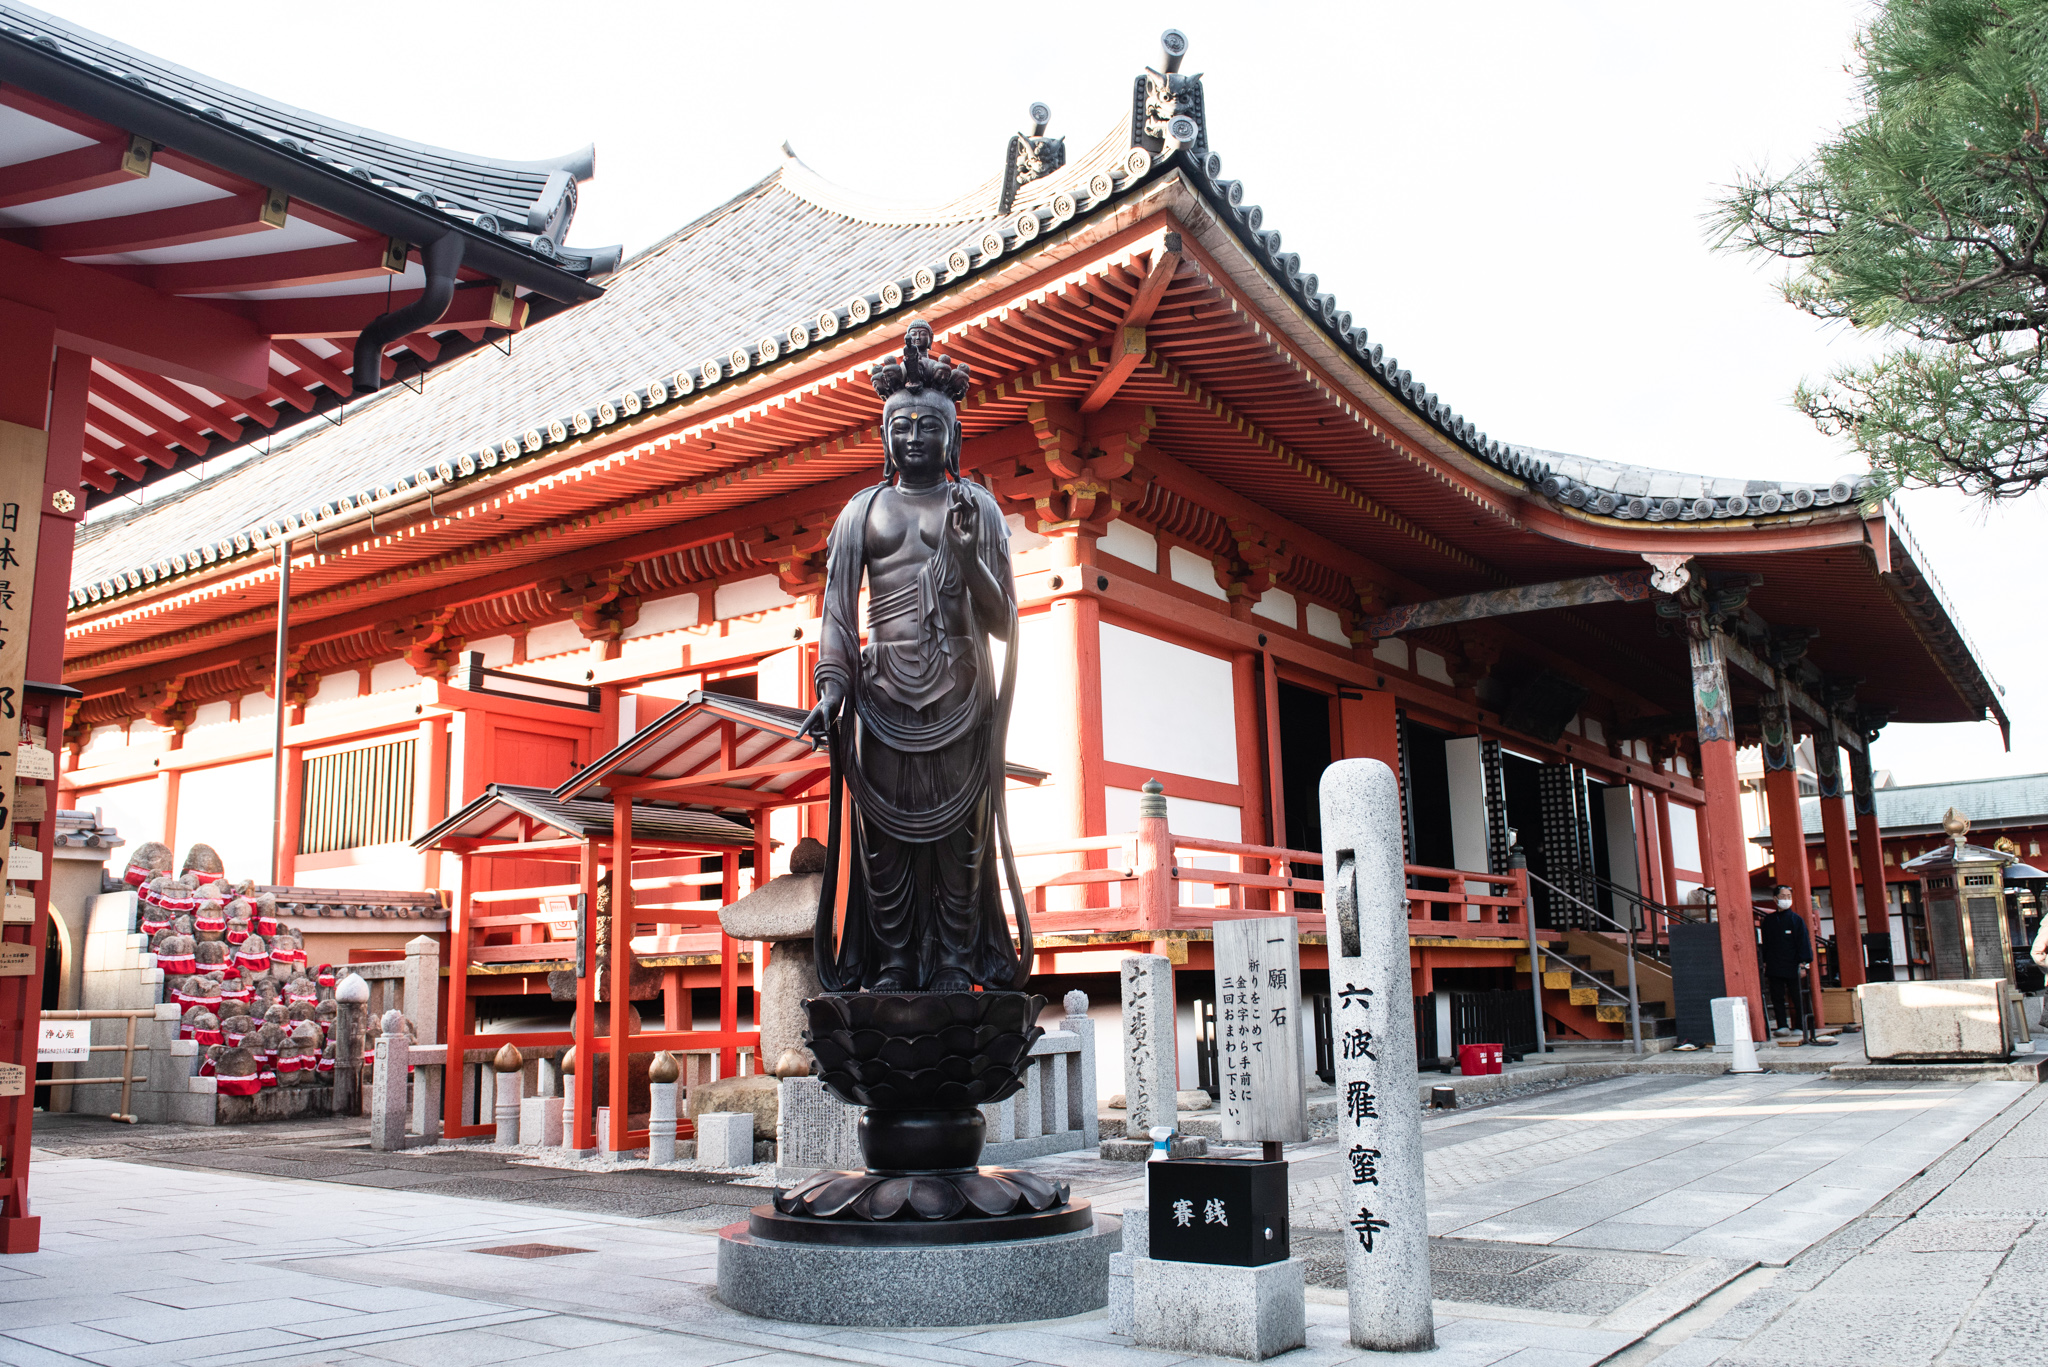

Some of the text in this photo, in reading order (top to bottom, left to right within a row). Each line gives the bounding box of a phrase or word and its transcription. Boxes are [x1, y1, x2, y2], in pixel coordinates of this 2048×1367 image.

[1248, 959, 1263, 1053] 祈りをこめて
[1266, 937, 1288, 1028] 一願石
[1222, 977, 1241, 1126] 三回おまわし下さい。
[1236, 975, 1253, 1101] 金文字から手前に
[1338, 983, 1389, 1253] 六波羅蜜寺
[1172, 1198, 1229, 1228] 賽銭
